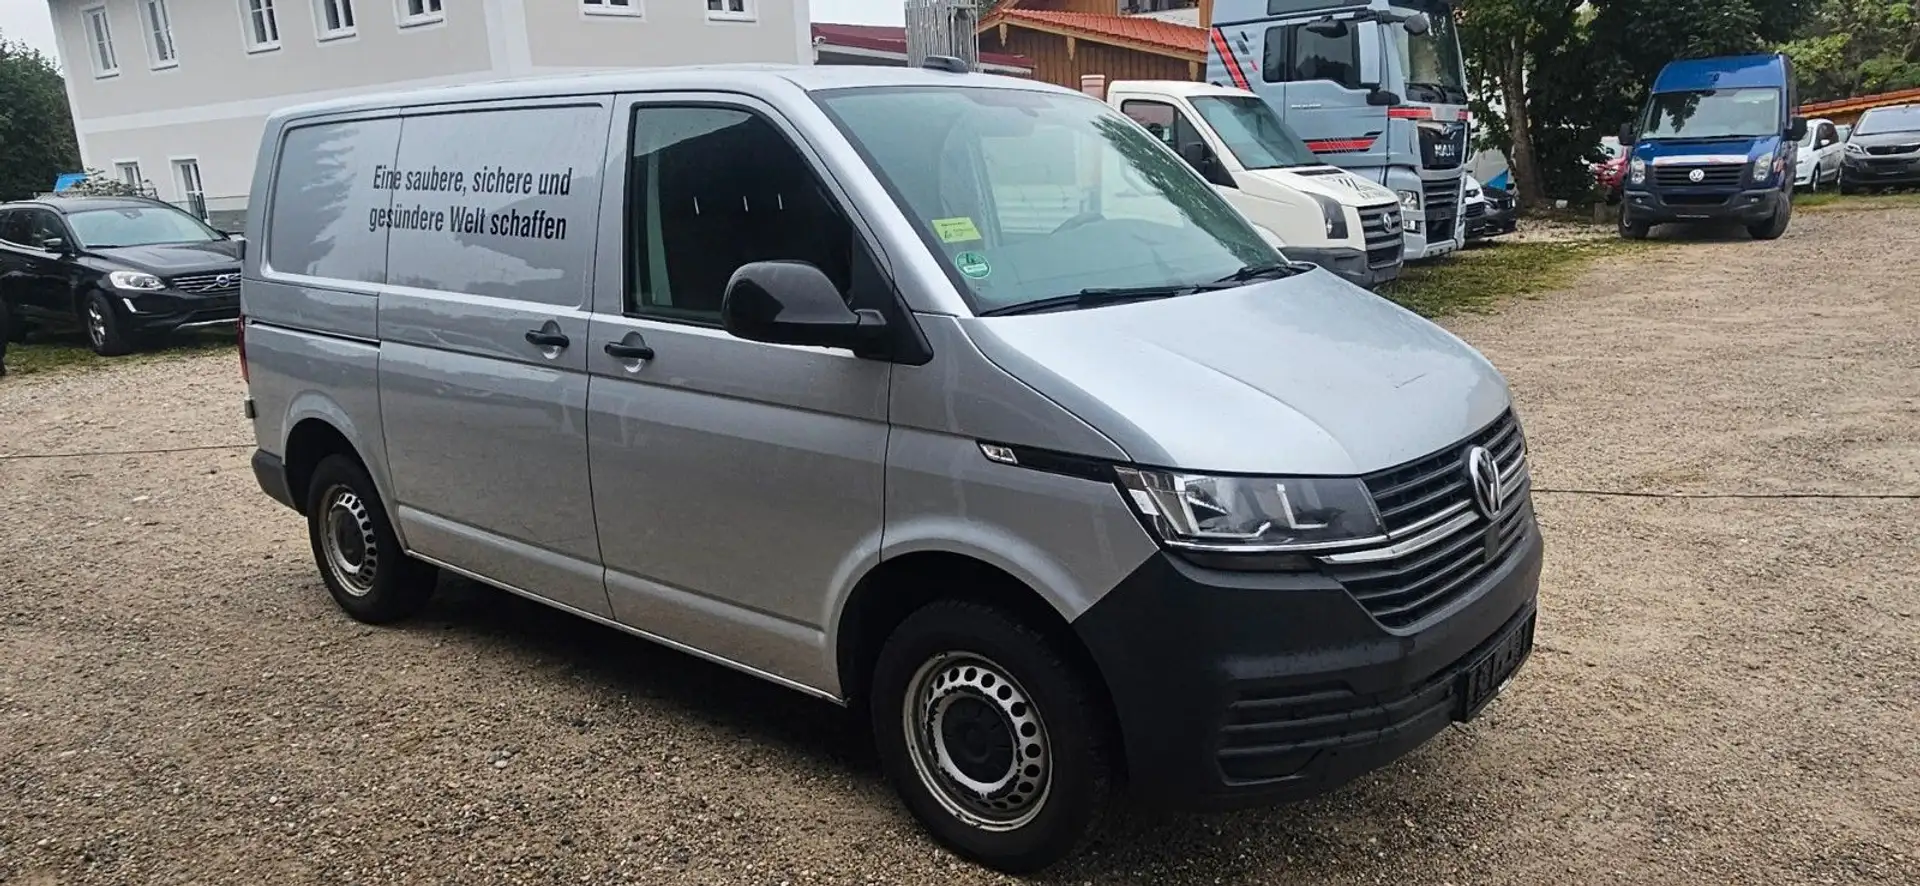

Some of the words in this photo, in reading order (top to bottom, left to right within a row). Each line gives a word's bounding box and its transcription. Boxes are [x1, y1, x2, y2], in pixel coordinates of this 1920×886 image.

[373, 165, 401, 189] Eine
[405, 166, 467, 196] saubere,
[472, 166, 533, 195] sichere
[538, 167, 573, 196] und
[369, 204, 444, 232] gesündere
[450, 205, 486, 234] Welt
[489, 208, 567, 240] schaffen
